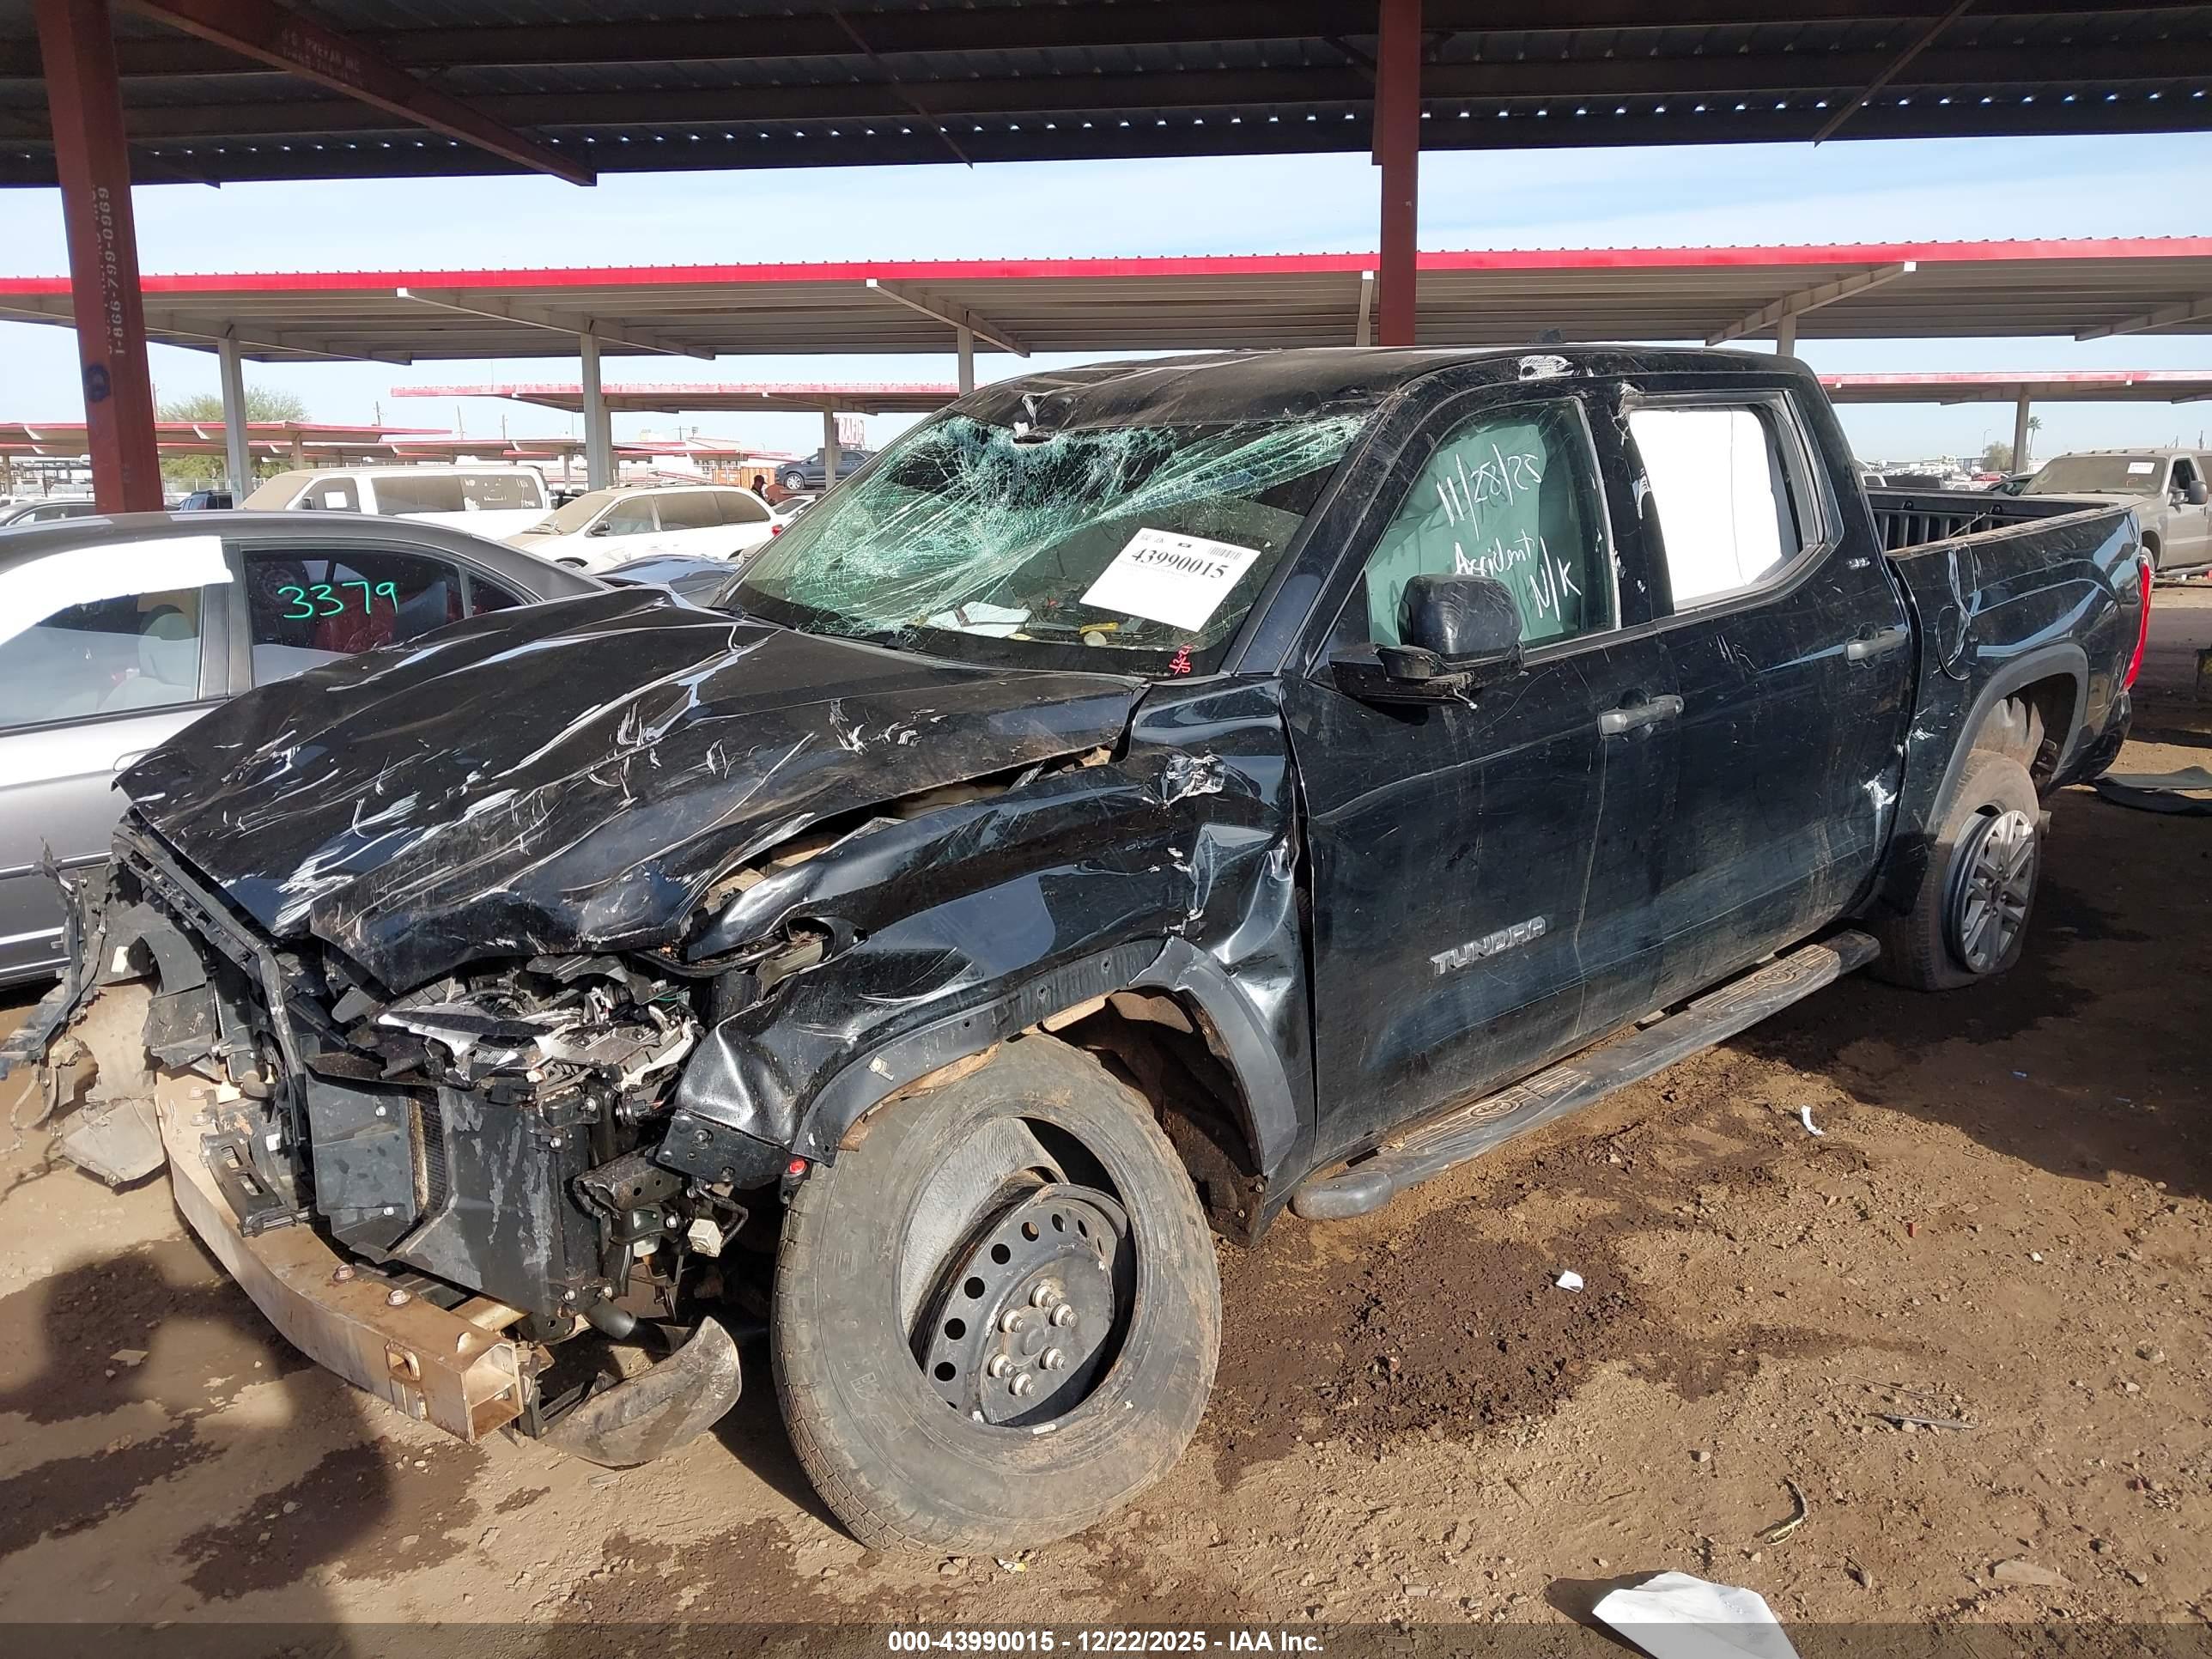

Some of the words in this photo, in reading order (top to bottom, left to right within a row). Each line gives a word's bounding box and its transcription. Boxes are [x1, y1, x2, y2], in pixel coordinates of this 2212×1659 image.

[97, 186, 125, 356] 1-866-799-0969
[1436, 443, 1542, 543] 11/28/25
[1132, 548, 1230, 579] 43990015
[277, 580, 399, 618] 3379
[1430, 915, 1546, 975] TUNDRA
